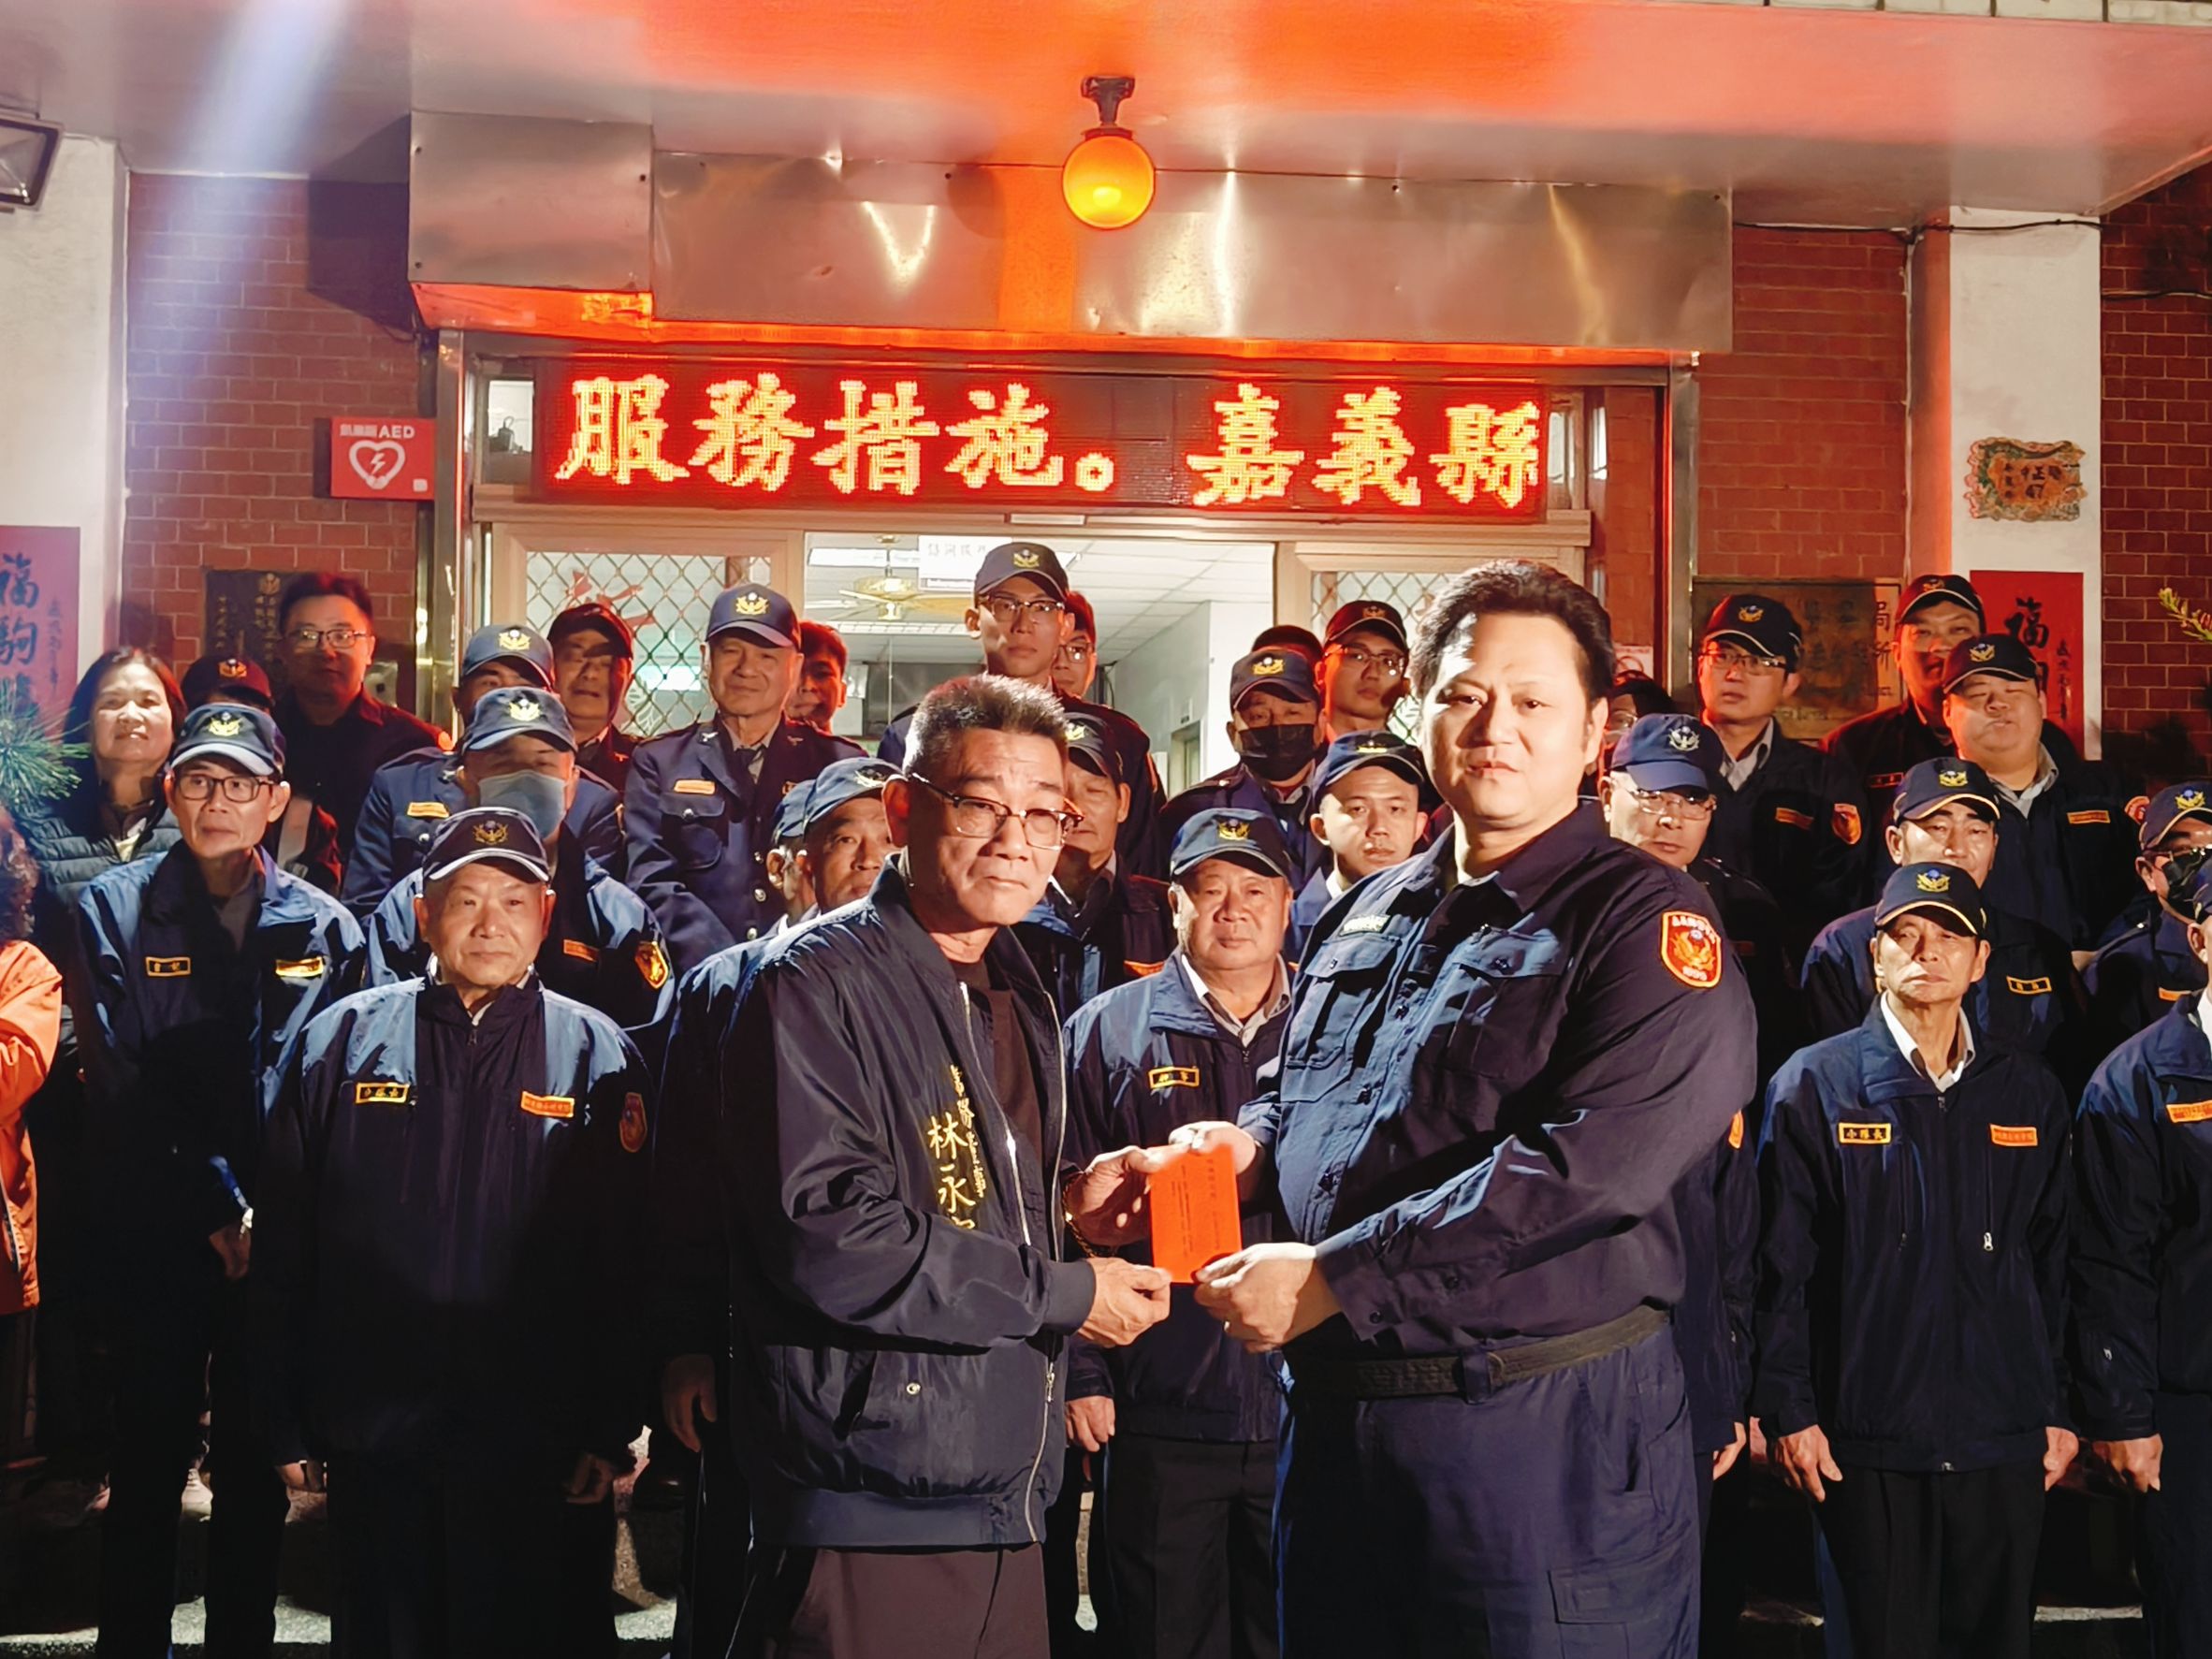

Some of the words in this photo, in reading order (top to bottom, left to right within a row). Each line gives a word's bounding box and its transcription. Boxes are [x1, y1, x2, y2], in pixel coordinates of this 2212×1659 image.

[378, 424, 415, 440] AED
[555, 372, 1114, 495] 服務措施。
[1186, 383, 1541, 508] 嘉義縣
